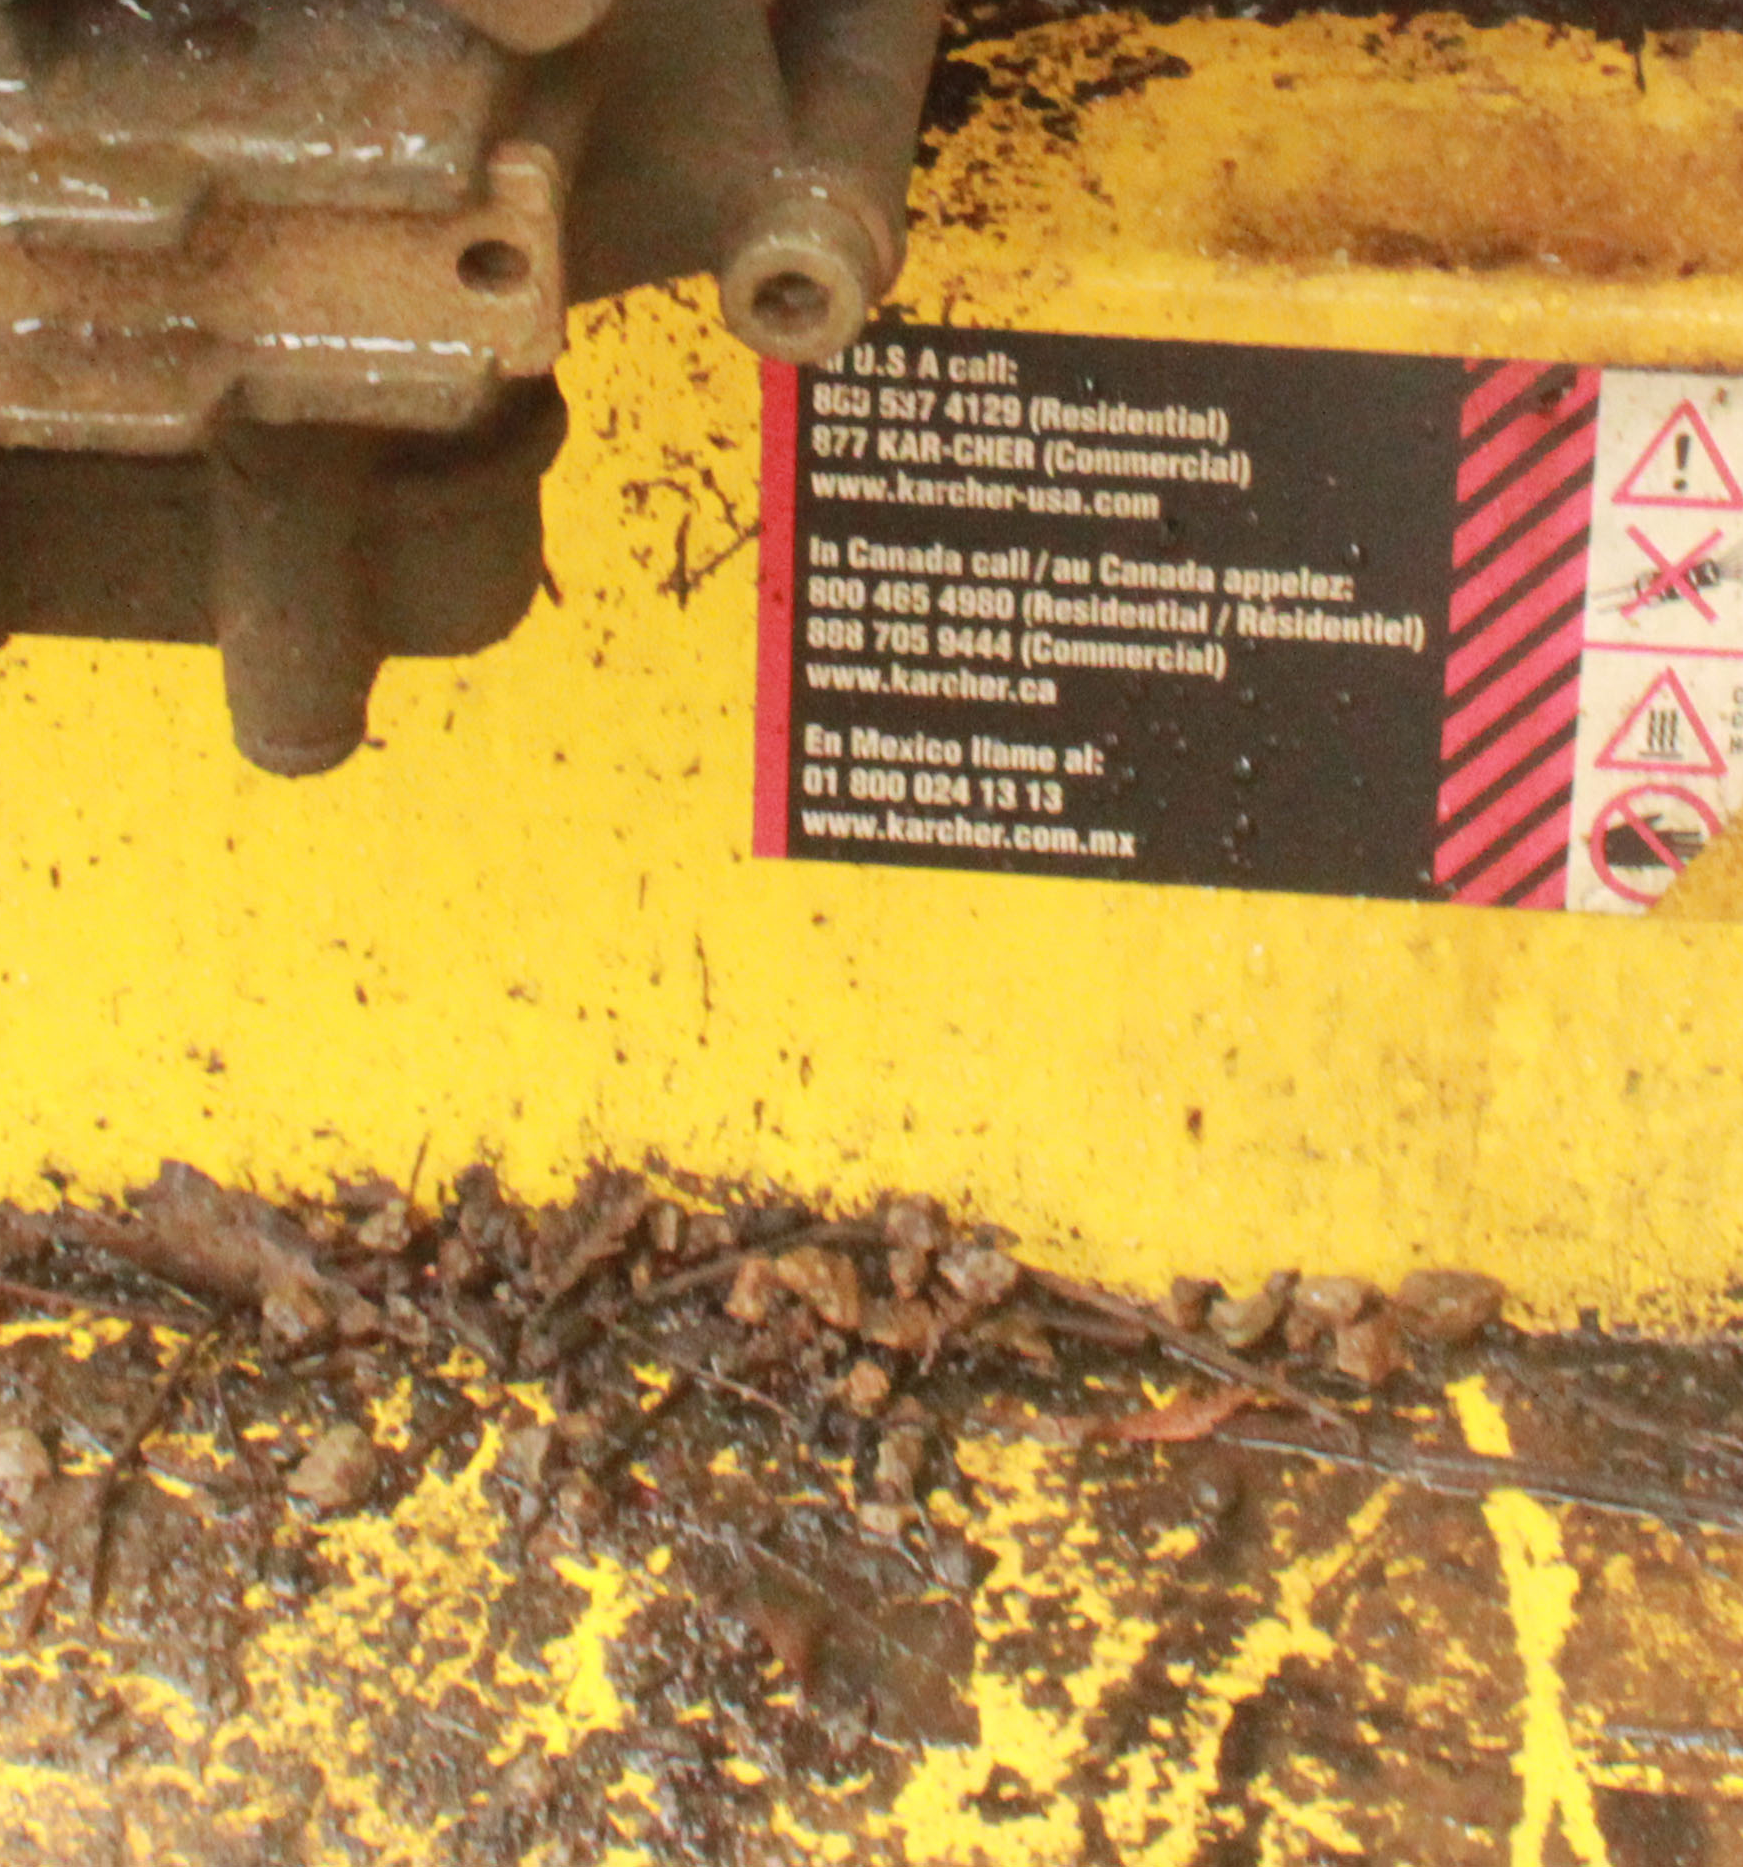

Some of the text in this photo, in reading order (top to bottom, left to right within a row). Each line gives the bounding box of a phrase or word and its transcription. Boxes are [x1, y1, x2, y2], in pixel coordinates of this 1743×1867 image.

[917, 347, 941, 381] A
[949, 352, 1020, 386] call:
[944, 391, 1023, 430] 4129
[1028, 396, 1230, 447] (Residential)
[811, 424, 1252, 491] 877 KAR-CHER (Commercial)
[811, 469, 1161, 520] www.karcher-usa.com
[809, 534, 839, 569] In
[847, 537, 963, 577] Canada
[1098, 552, 1217, 594] Canada
[1223, 566, 1354, 603] appelez:
[808, 575, 1426, 654] 800 465 4980 (Residential / Résidentiel)
[807, 616, 1228, 682] 888 705 9444 (Commercial)
[806, 661, 1057, 705] www.karcher.ca
[804, 722, 1105, 776] En Mexico llame al:
[802, 763, 1064, 815] 01 800 024 13 13
[801, 809, 1138, 858] www.karcher.com.mx
